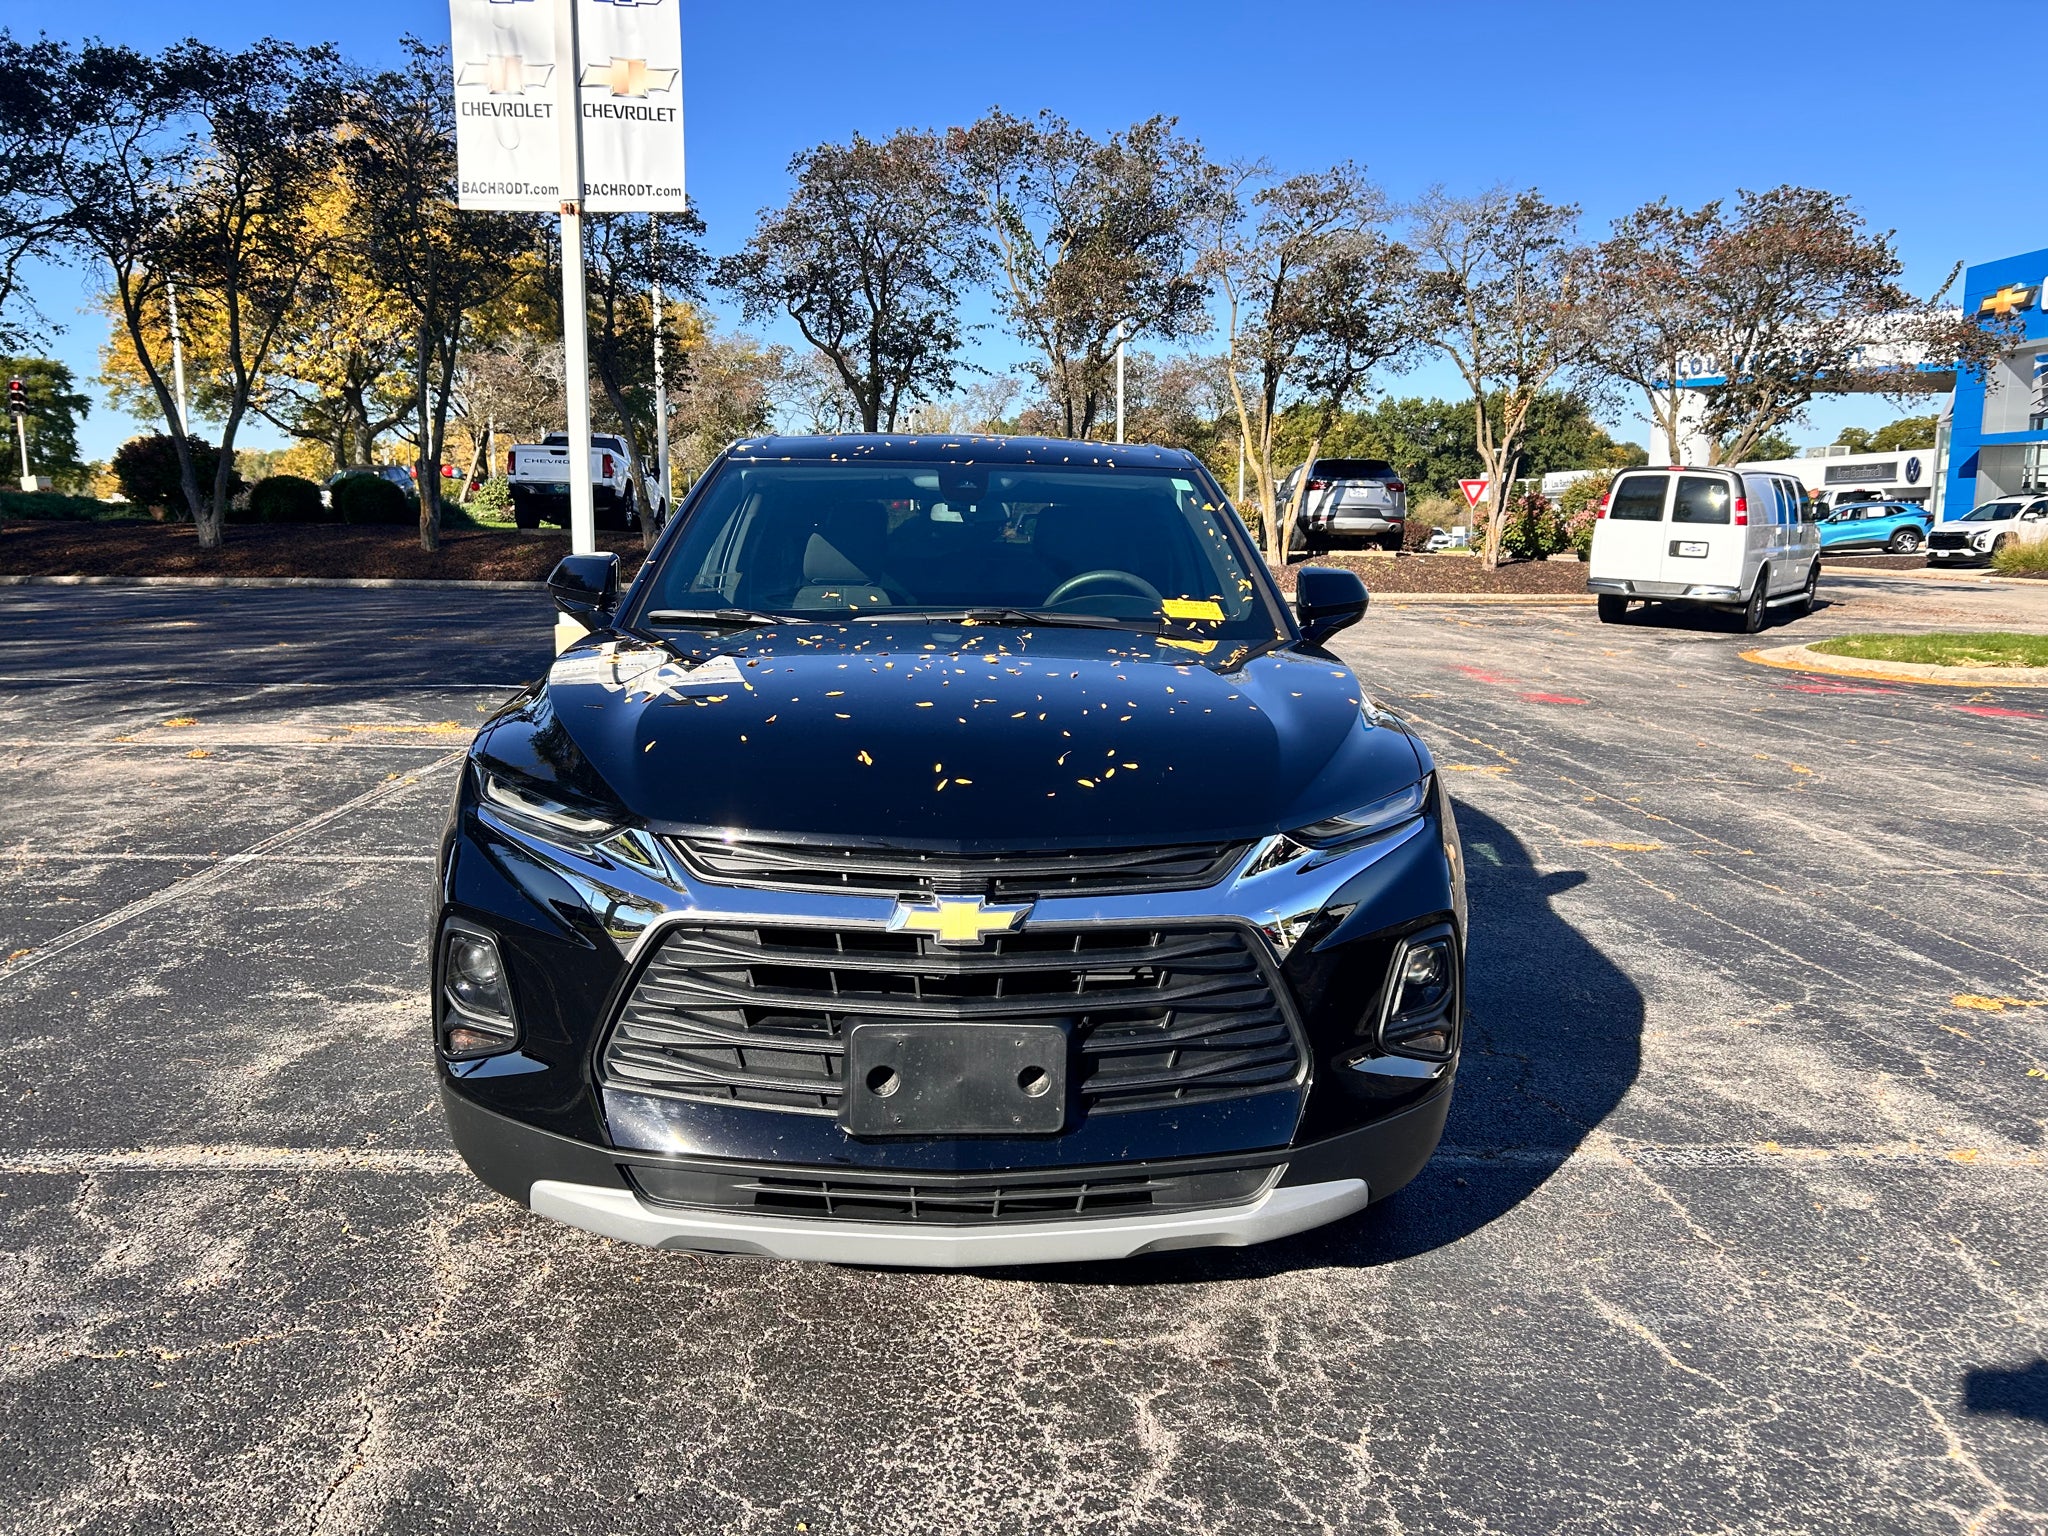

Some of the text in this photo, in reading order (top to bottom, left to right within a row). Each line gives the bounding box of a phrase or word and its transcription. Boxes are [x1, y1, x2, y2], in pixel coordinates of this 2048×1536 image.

[461, 101, 553, 118] CHEVROLET
[583, 103, 677, 122] CHEVROLET
[461, 181, 559, 196] BACHRODT.com
[583, 183, 682, 197] BACHRODT.com
